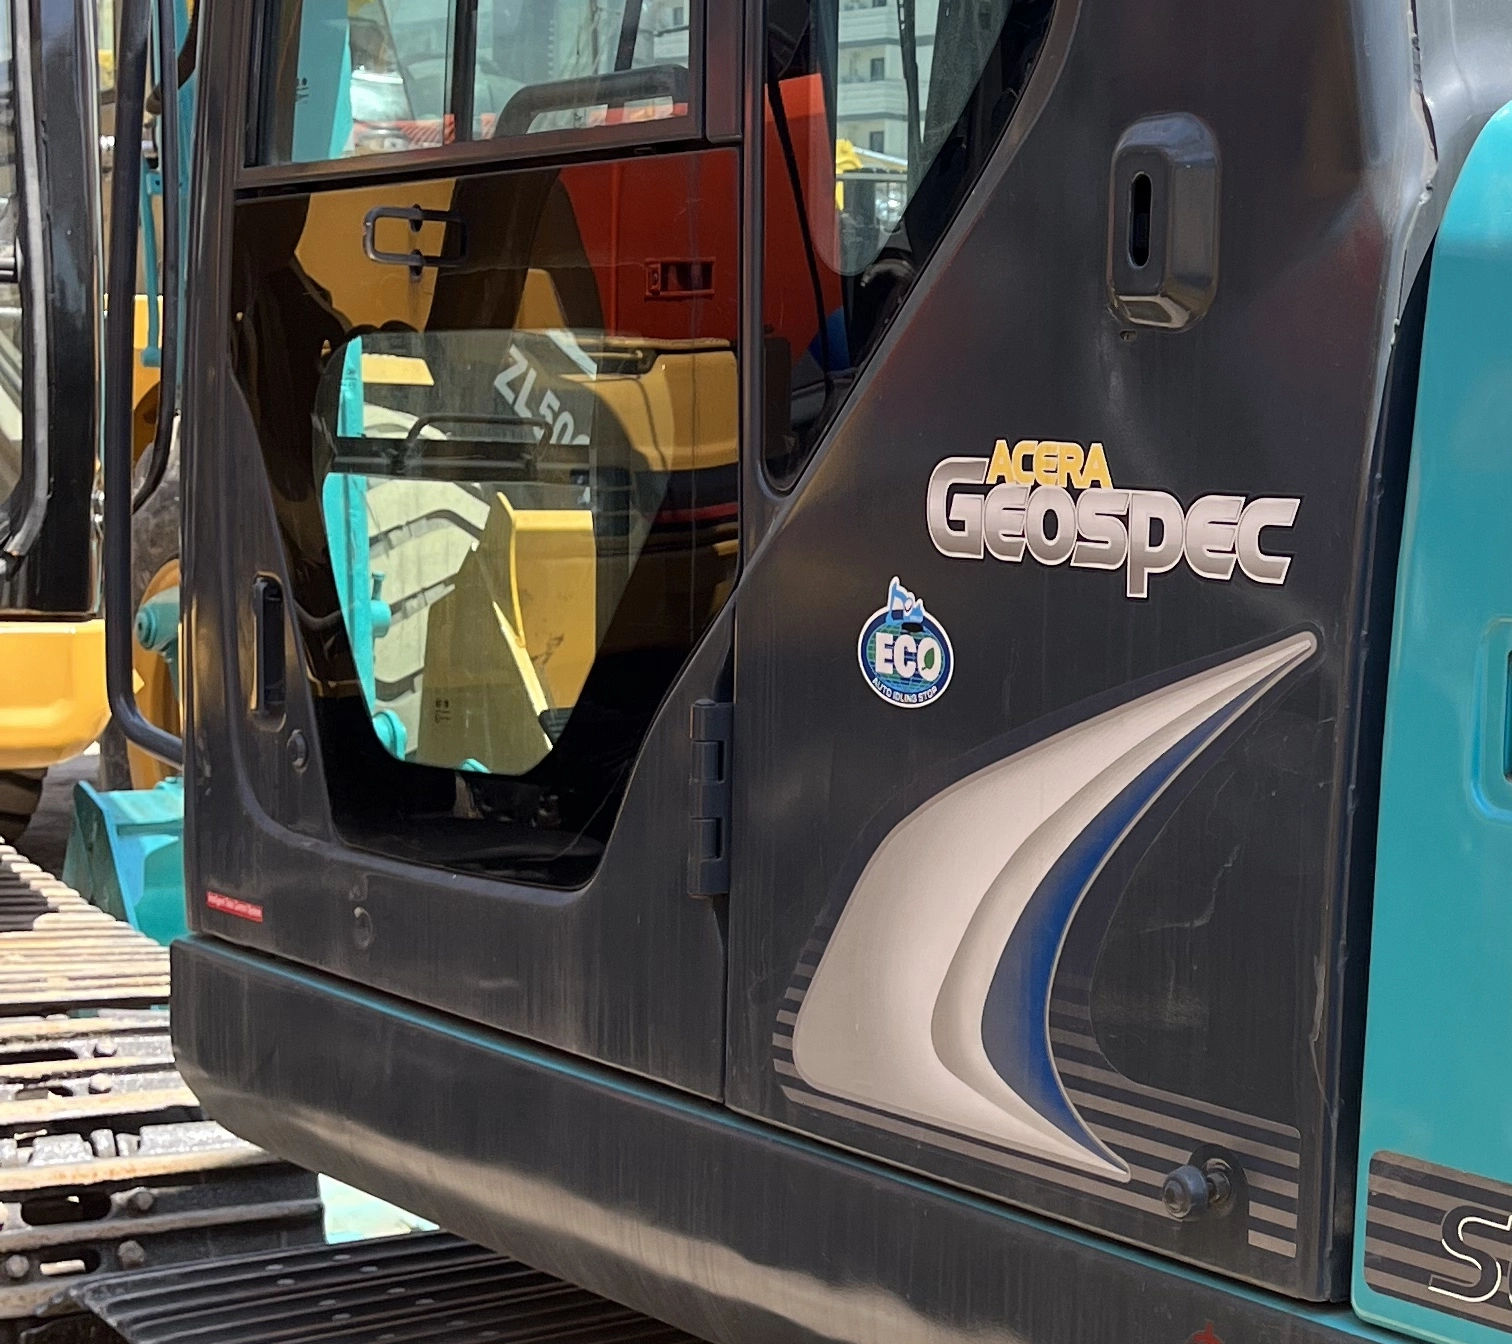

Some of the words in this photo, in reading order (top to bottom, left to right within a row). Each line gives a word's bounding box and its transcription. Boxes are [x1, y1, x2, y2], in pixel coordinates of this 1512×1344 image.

[494, 343, 590, 444] ZL50
[988, 439, 1112, 489] ACERA
[926, 455, 1301, 598] GEOSPEC
[875, 631, 942, 682] ECO
[872, 677, 892, 698] AUTO
[892, 690, 917, 704] IDLING
[917, 685, 938, 703] STOP
